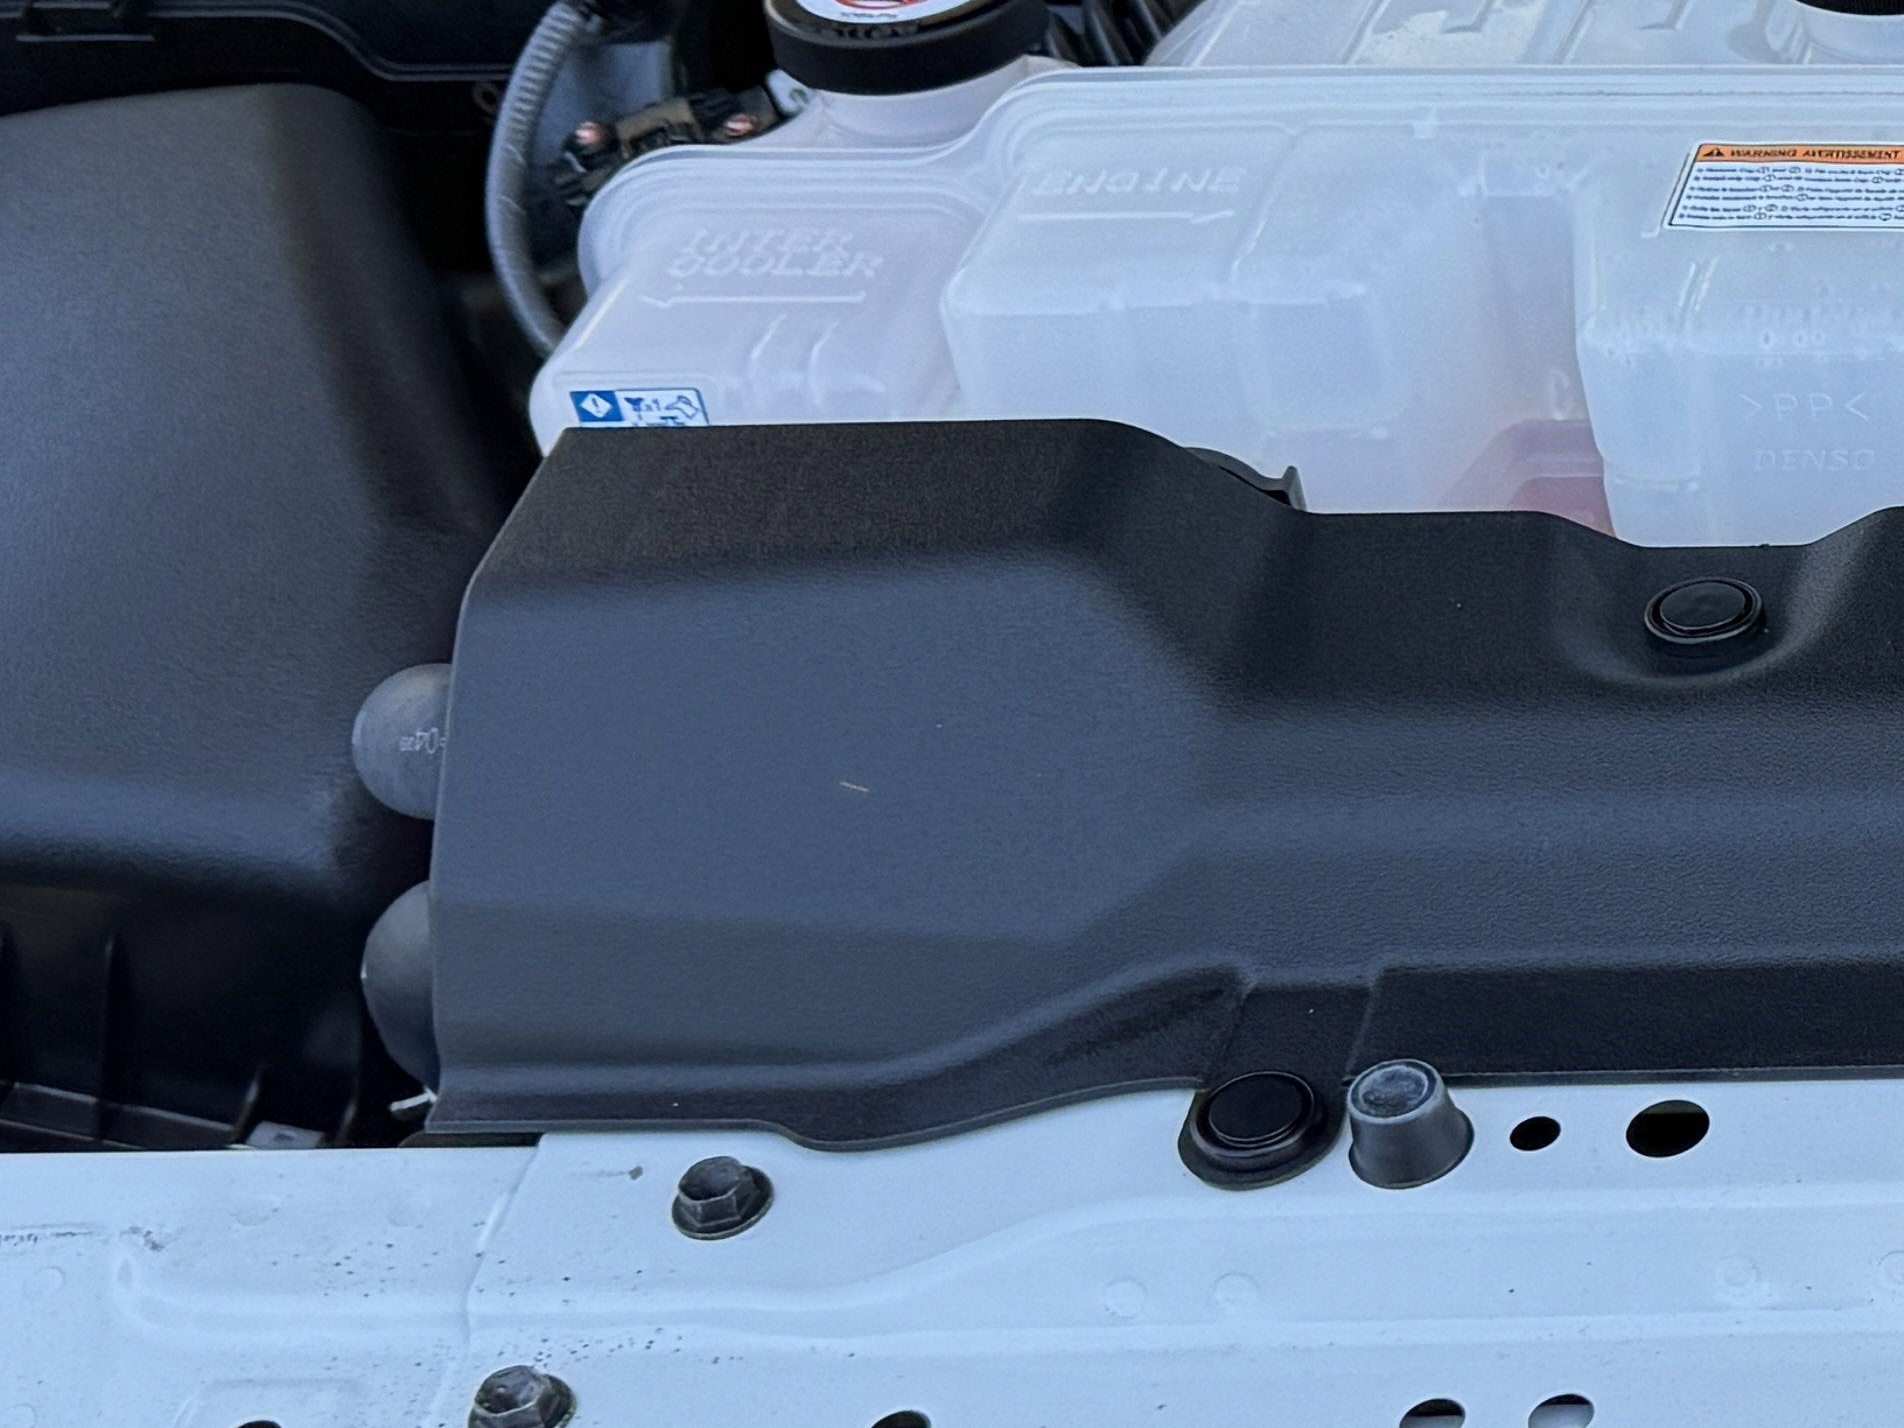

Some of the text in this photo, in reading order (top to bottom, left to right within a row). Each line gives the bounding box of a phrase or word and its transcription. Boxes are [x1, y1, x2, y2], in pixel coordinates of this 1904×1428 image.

[1729, 147, 1799, 159] WARNING
[1031, 165, 1249, 196] ENGINE
[665, 250, 885, 279] COOLER
